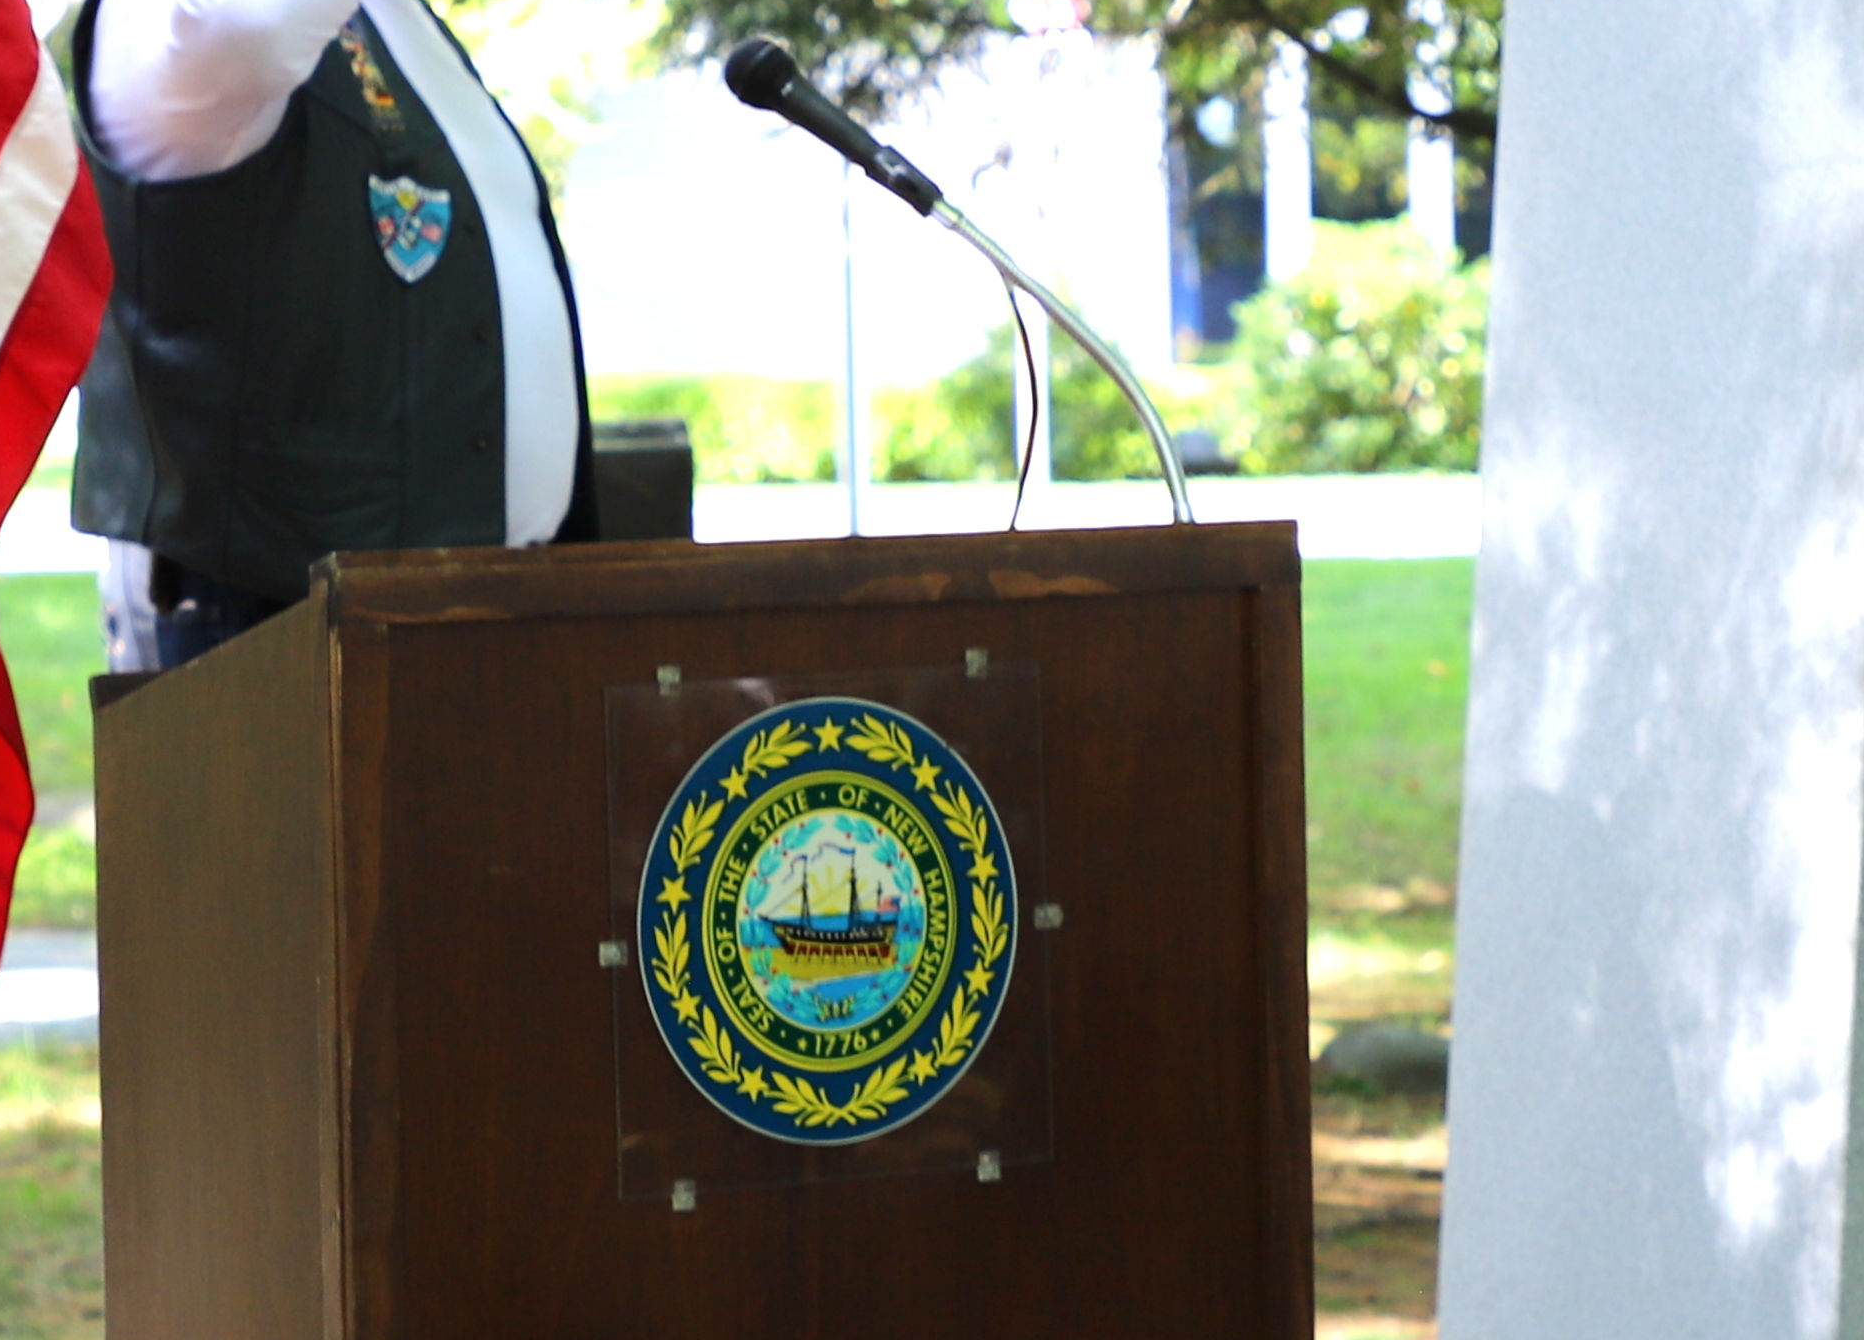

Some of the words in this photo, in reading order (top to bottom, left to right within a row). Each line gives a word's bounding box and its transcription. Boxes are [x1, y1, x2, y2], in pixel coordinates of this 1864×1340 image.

[750, 788, 809, 841] STATE
[837, 784, 870, 810] OF
[883, 803, 931, 856] NEW
[718, 854, 748, 903] THE
[716, 926, 737, 963] OF
[897, 866, 947, 1022] HAMPSHIRE
[731, 975, 775, 1033] SEAL
[815, 1029, 868, 1058] 1776
